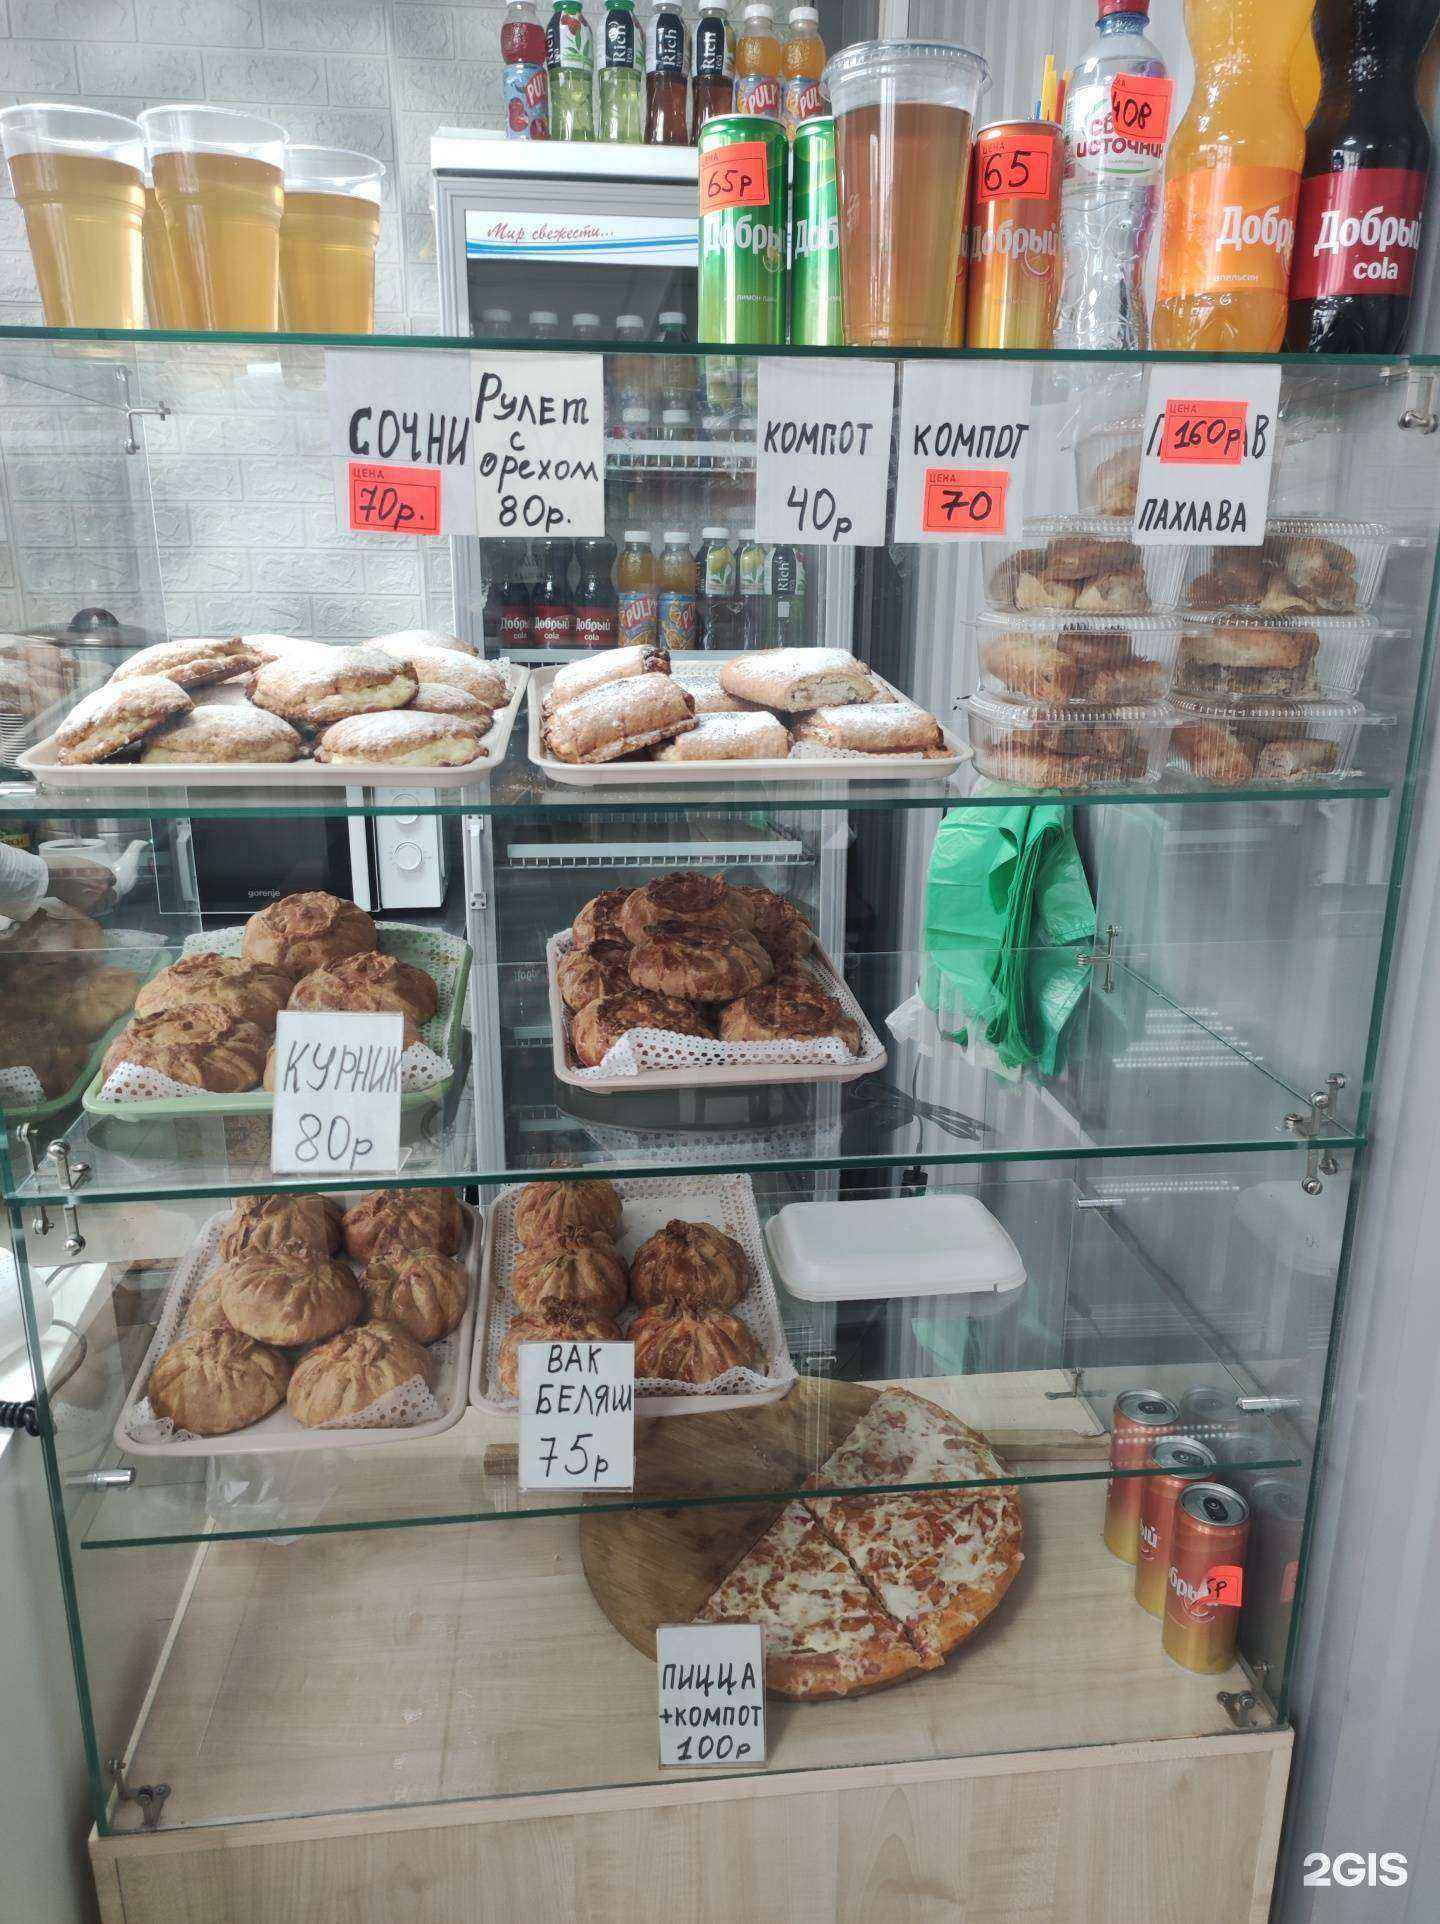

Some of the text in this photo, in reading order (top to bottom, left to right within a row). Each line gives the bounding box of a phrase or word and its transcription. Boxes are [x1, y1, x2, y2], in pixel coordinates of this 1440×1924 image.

[613, 25, 626, 63] Rich
[663, 29, 677, 67] Rich
[702, 31, 717, 71] Rich
[984, 150, 1032, 192] 65
[487, 222, 525, 243] Мир
[1353, 256, 1399, 280] cola
[1168, 402, 1198, 414] ЦЕНА
[349, 406, 470, 466] СОЧНИ
[763, 420, 874, 457] КОМПОТ
[913, 422, 1030, 460] КОМПОТ
[1173, 418, 1241, 456] 160р
[353, 466, 385, 480] ЦЕНА
[479, 451, 599, 494] орехом
[928, 472, 957, 484] ЦЕНА
[359, 484, 426, 531] 70р.
[499, 493, 572, 533] 80р.
[786, 485, 853, 542] 40р
[941, 489, 993, 521] 70
[1138, 497, 1248, 533] ПАХЛАВА
[777, 561, 789, 592] Rich
[544, 632, 561, 641] cola
[576, 617, 612, 633] Добрый
[584, 633, 600, 641] cola
[247, 889, 281, 899] gorenje
[283, 1040, 401, 1094] КУРНИК
[295, 1113, 373, 1171] 80р
[547, 1344, 602, 1375] ВАК
[535, 1383, 632, 1417] БЕЛЯШ
[539, 1433, 609, 1483] 75р
[662, 1662, 756, 1698] ПИЦЦА
[659, 1705, 763, 1729] +КОМПОТ
